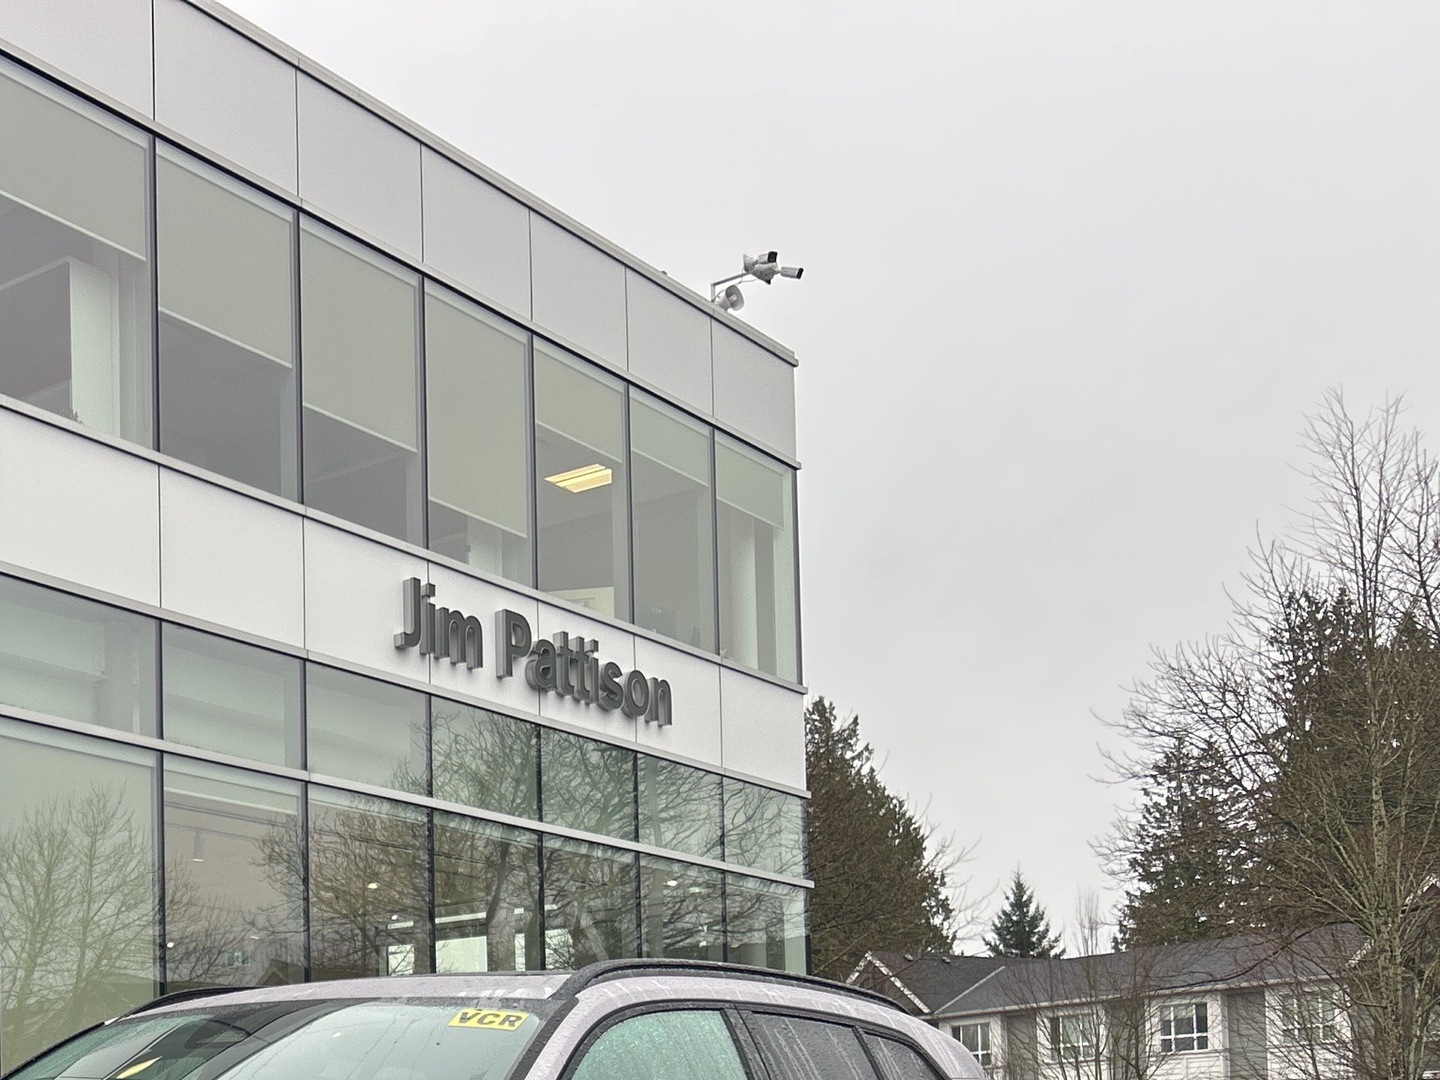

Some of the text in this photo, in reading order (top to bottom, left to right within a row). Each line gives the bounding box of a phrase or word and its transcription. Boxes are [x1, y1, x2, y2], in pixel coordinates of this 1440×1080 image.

[393, 576, 673, 727] Jim Pattison
[458, 1012, 522, 1028] VCR
